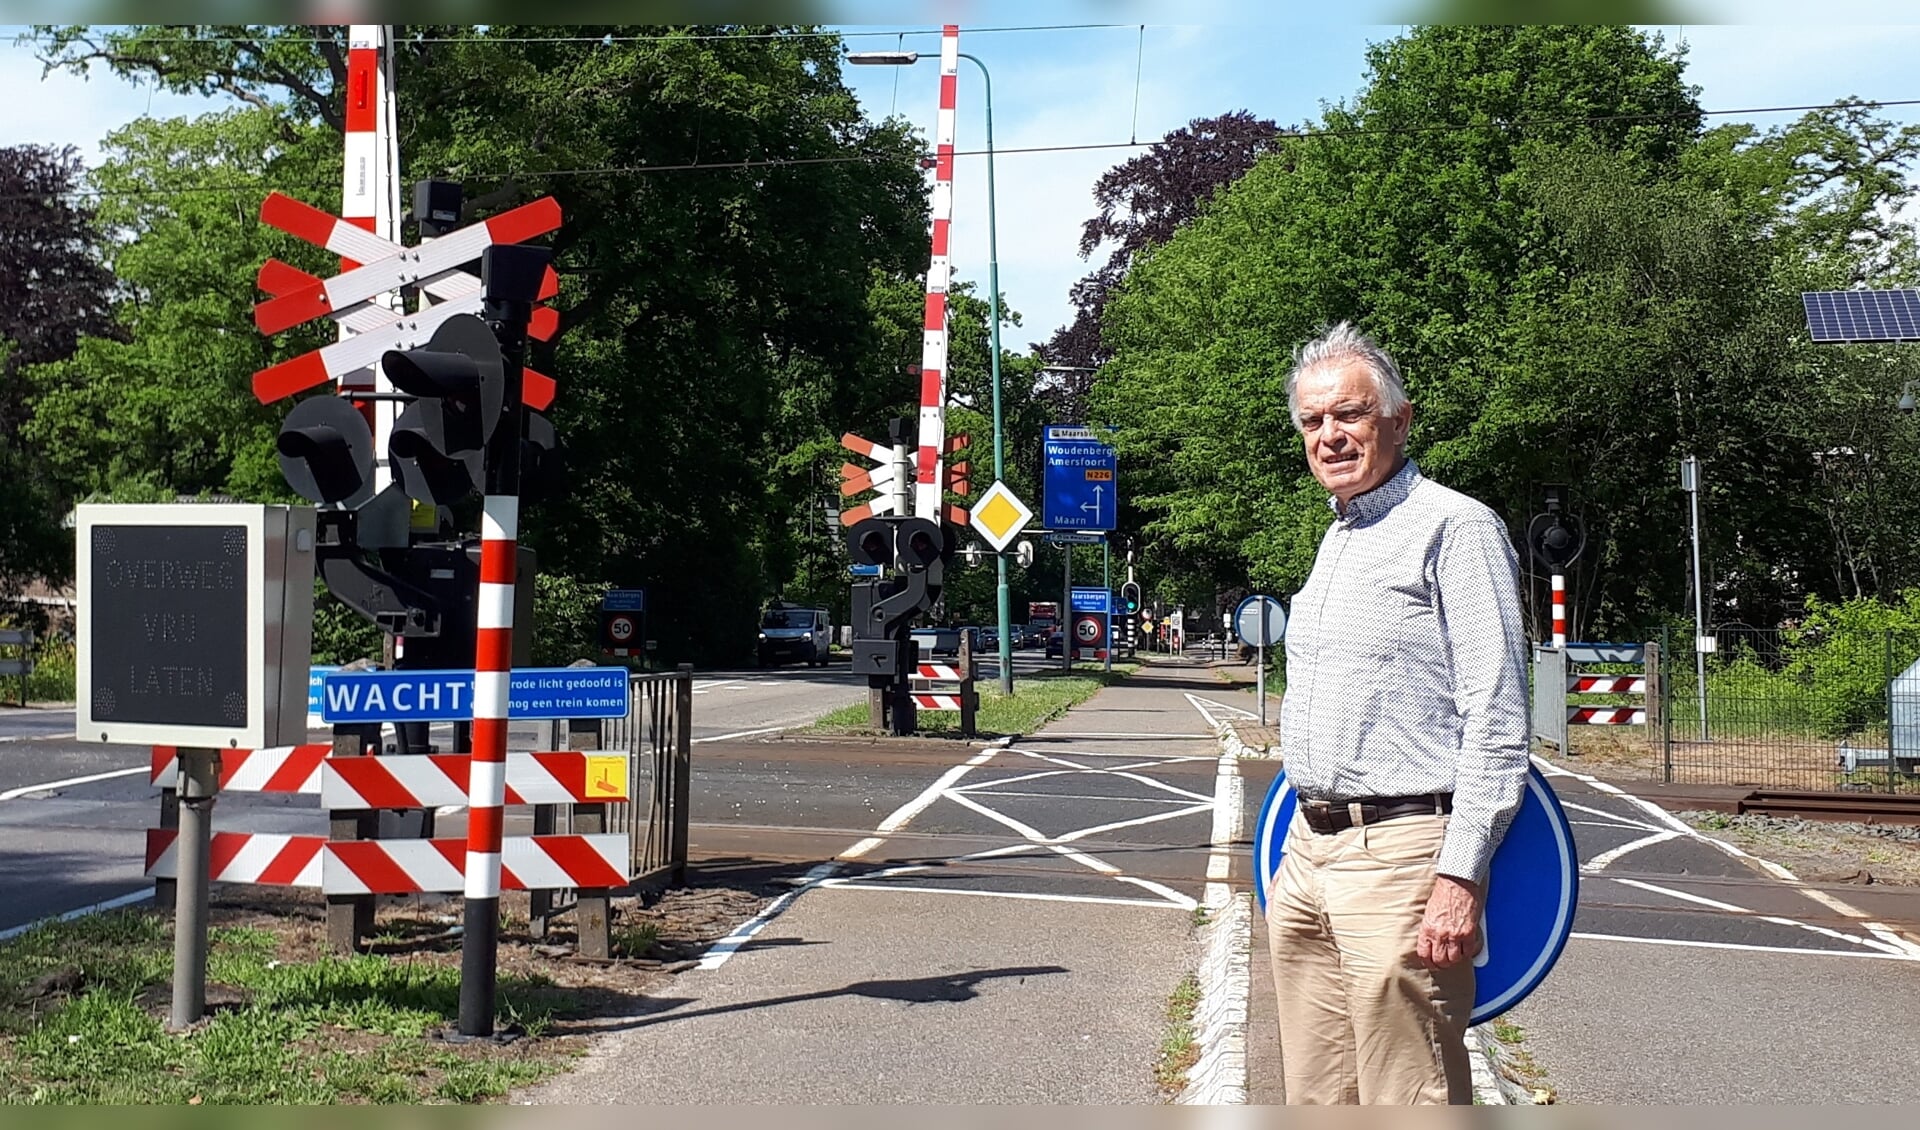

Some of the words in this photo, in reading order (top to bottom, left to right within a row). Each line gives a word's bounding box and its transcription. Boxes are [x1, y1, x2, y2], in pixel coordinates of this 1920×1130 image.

[1048, 446, 1113, 457] Woudenberg
[1048, 457, 1107, 466] Amersfoort
[1087, 471, 1110, 479] N226
[1055, 516, 1086, 525] Maarn
[106, 560, 233, 589] OVERWEG
[614, 623, 631, 634] 50
[1079, 625, 1097, 636] 50
[131, 665, 213, 695] LATEN
[511, 679, 536, 689] rode
[539, 678, 563, 688] licht
[566, 677, 611, 691] gedoofd
[614, 678, 623, 688] is
[508, 700, 529, 711] nog
[532, 700, 552, 708] een
[556, 697, 583, 707] trein
[586, 697, 623, 707] komen
